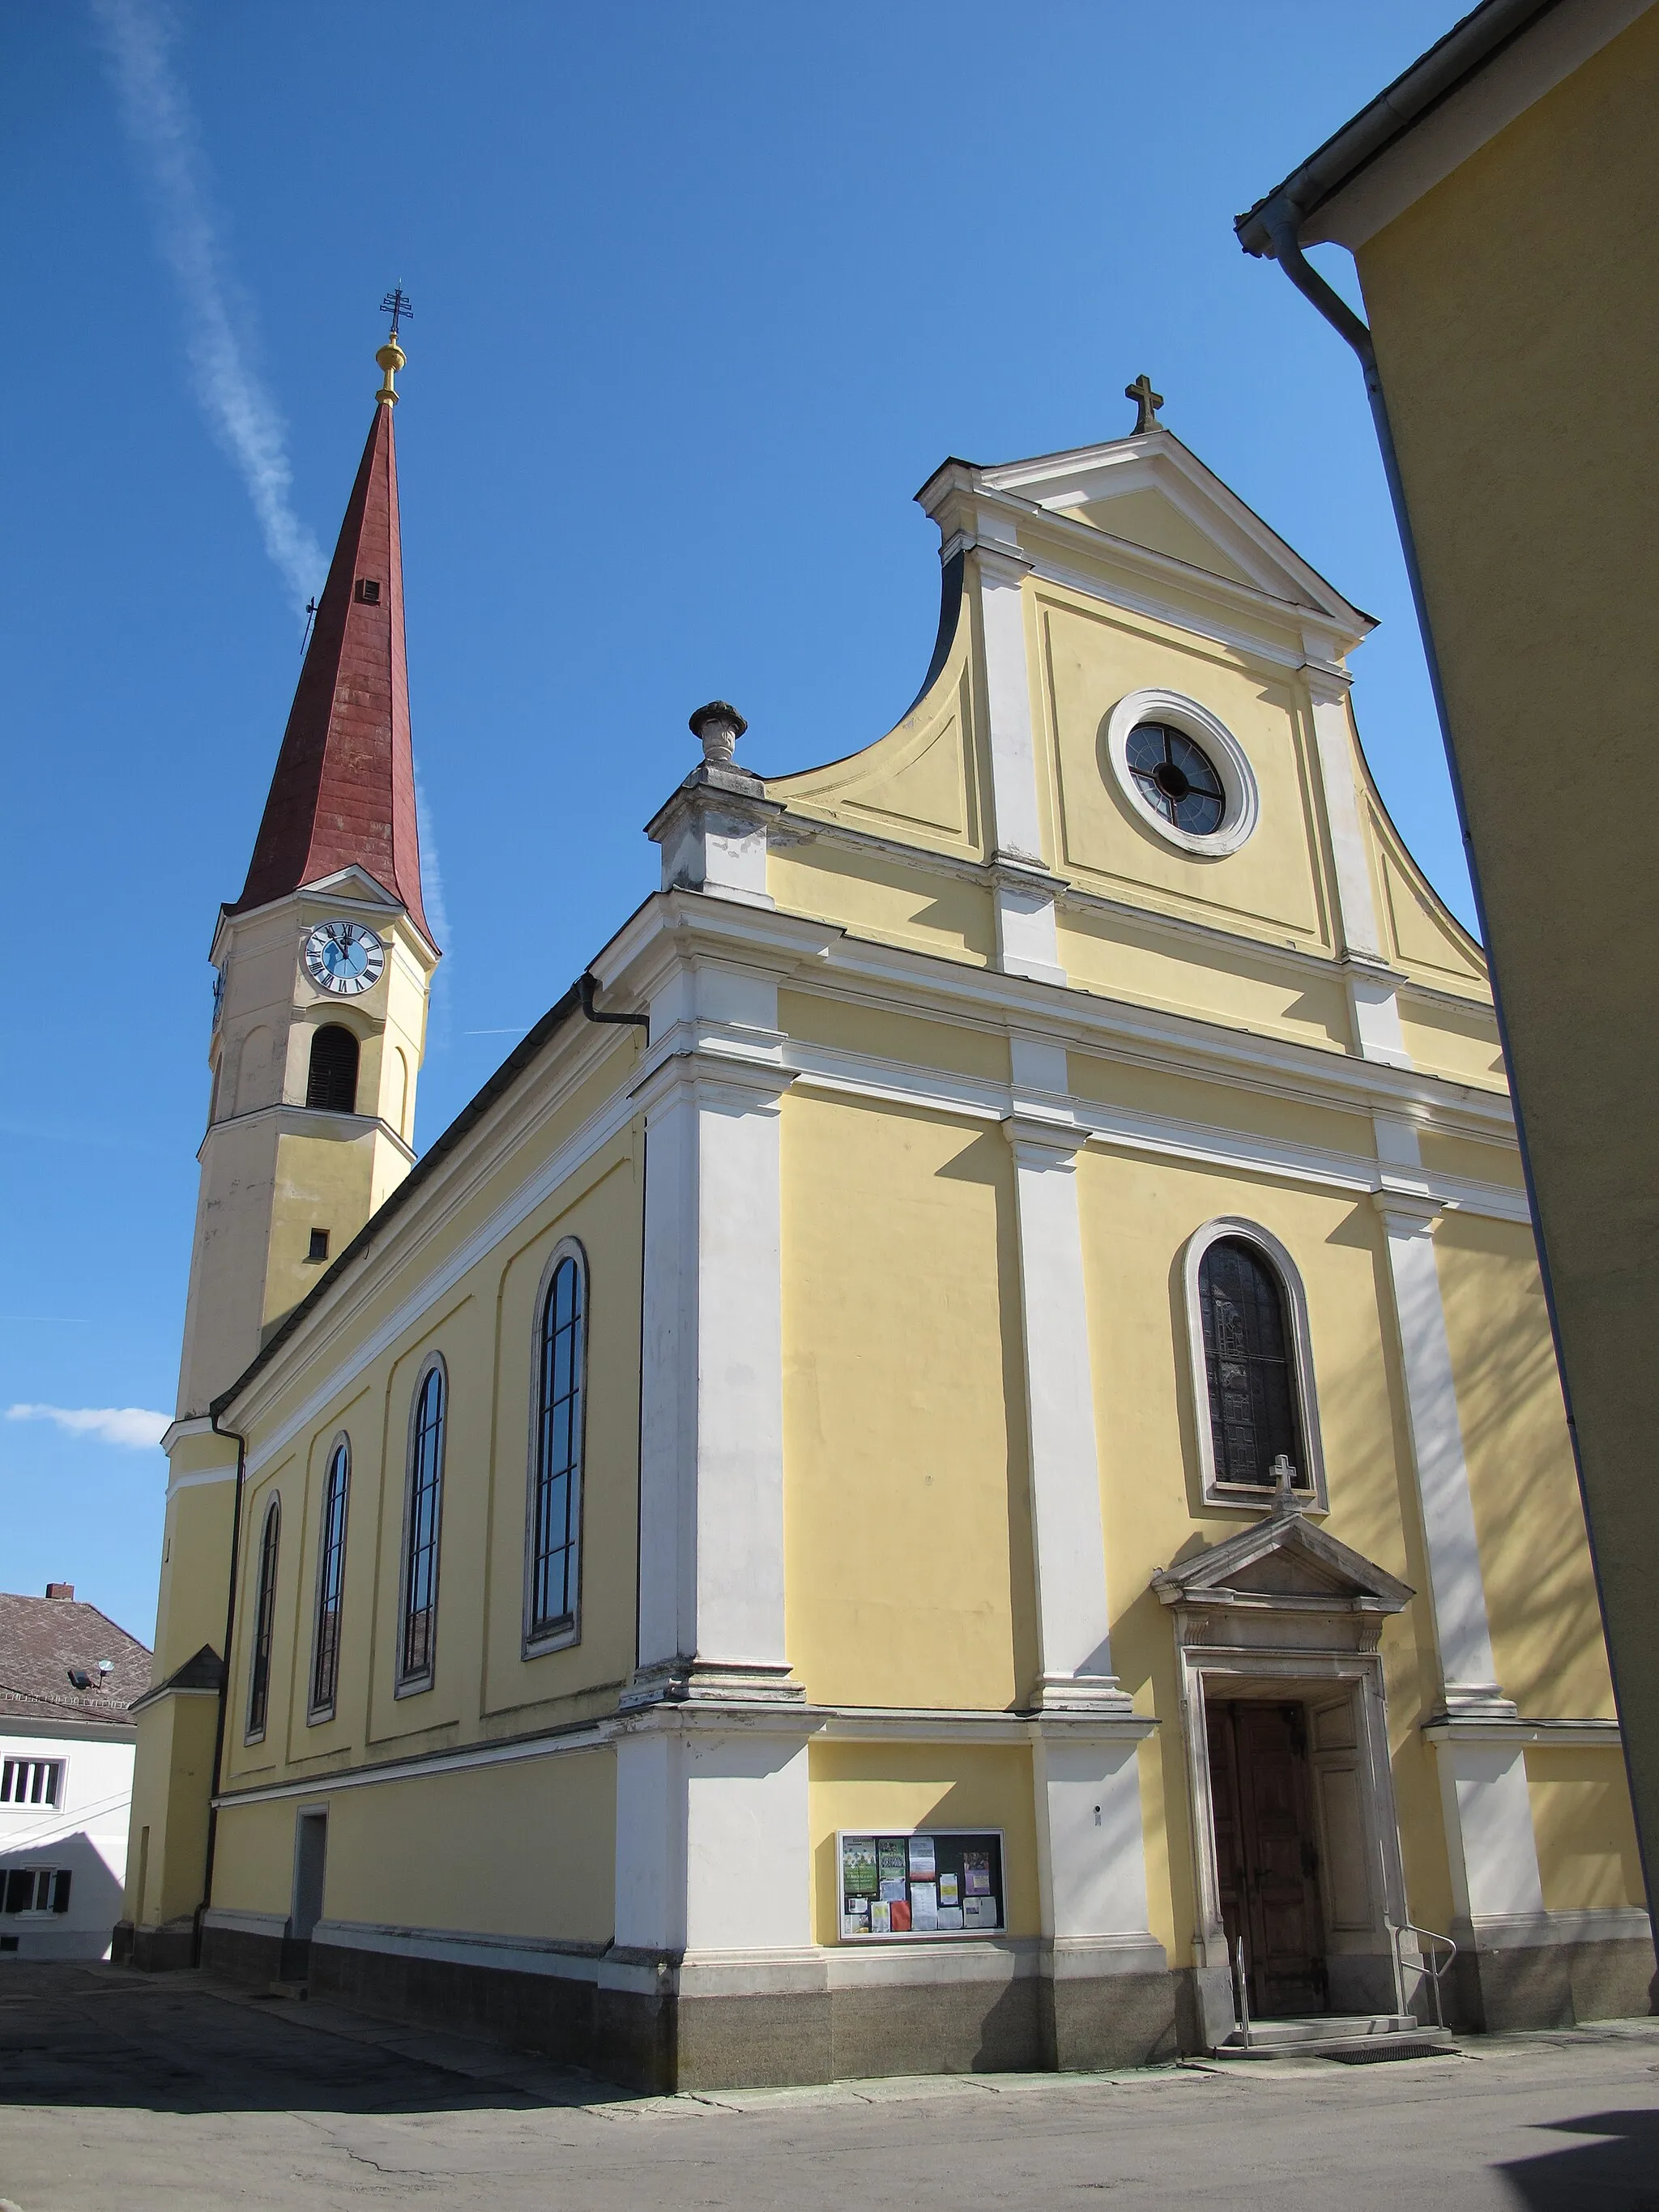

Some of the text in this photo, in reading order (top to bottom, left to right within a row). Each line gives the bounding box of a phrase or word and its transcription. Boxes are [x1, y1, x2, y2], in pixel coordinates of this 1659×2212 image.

[342, 923, 354, 937] XII
[312, 935, 326, 945] X
[358, 931, 367, 941] I
[307, 948, 321, 958] IX
[366, 944, 380, 953] II
[369, 958, 382, 967] III
[322, 973, 335, 988] VII
[362, 969, 378, 982] IIII
[338, 979, 348, 992] VI
[355, 978, 365, 991] V
